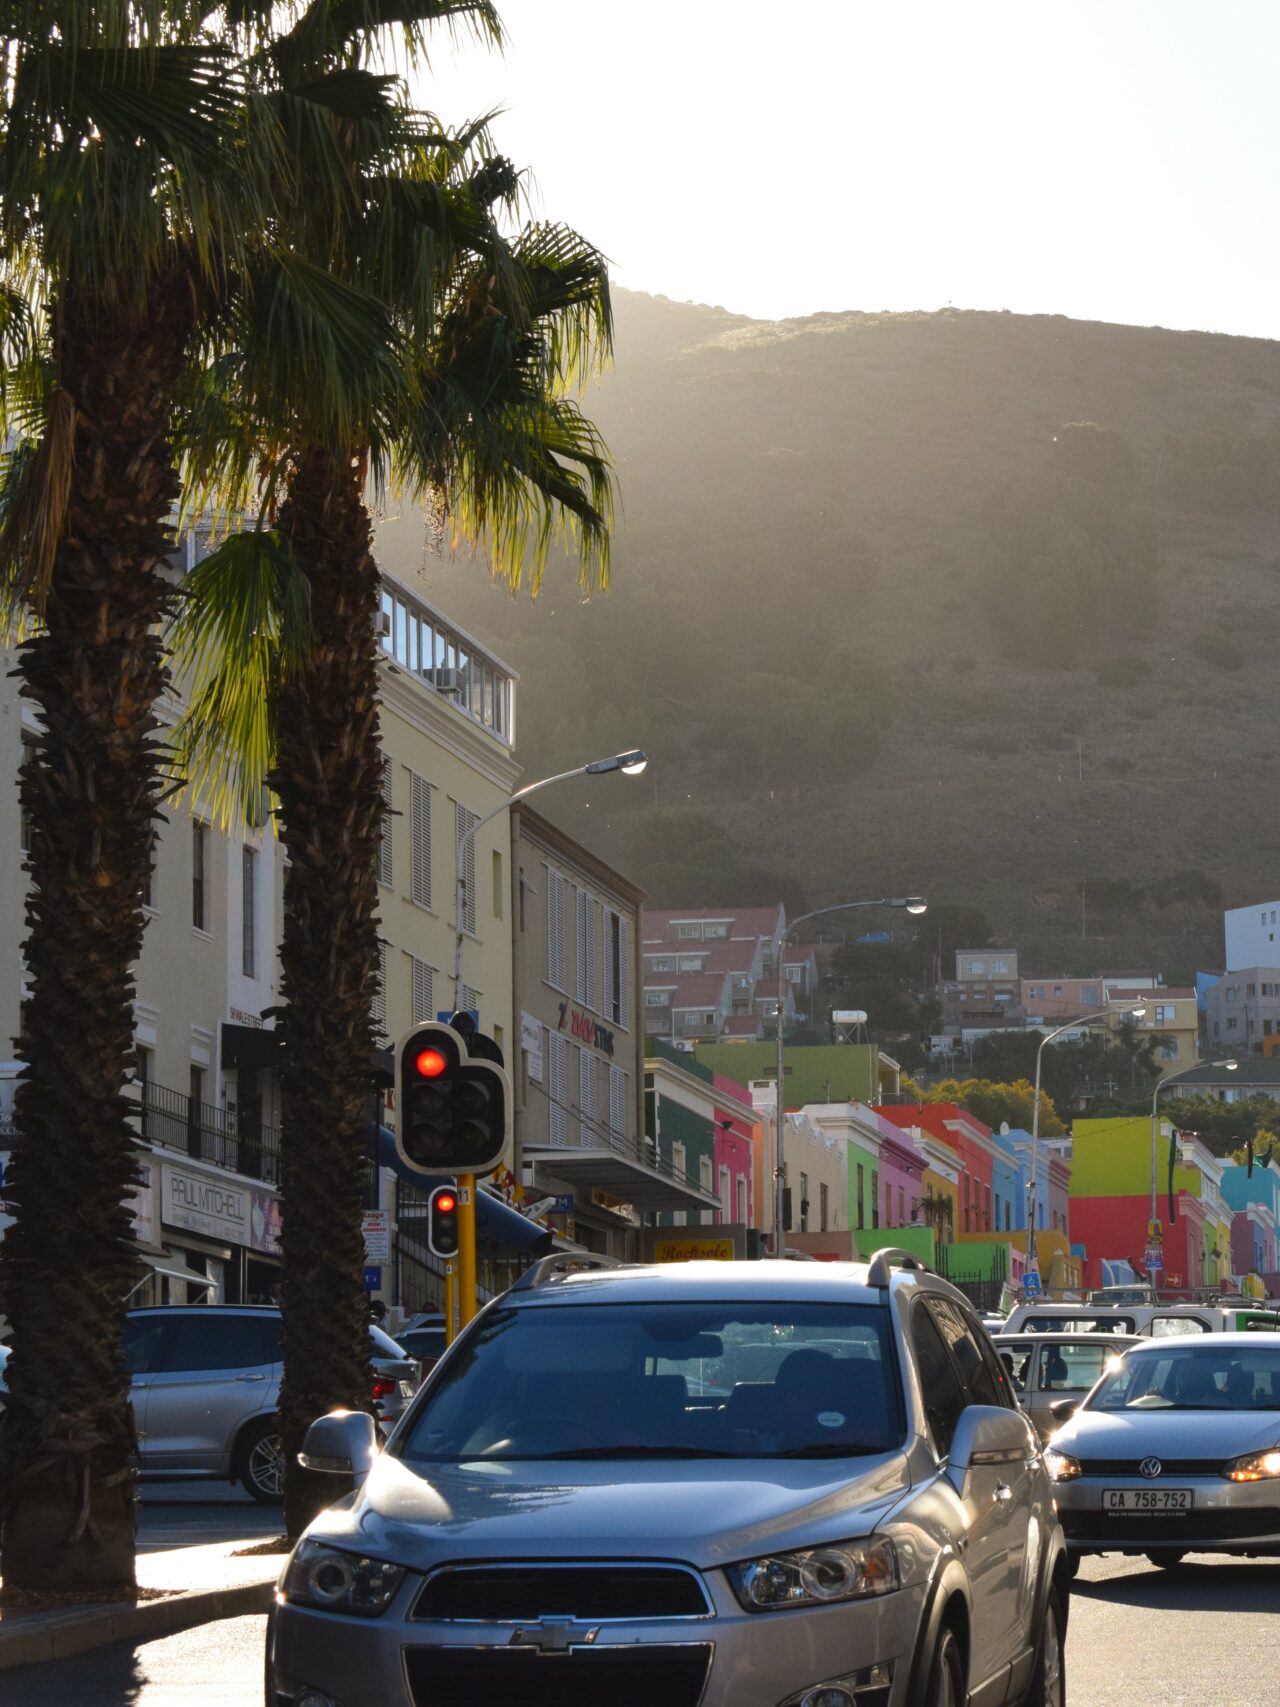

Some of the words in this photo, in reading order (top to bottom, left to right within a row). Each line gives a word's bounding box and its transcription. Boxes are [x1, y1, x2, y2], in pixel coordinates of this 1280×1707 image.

[171, 1177, 198, 1207] PAUL
[198, 1186, 244, 1221] MITCHELL
[1110, 1492, 1125, 1508] CA
[1134, 1492, 1186, 1508] 758-752
